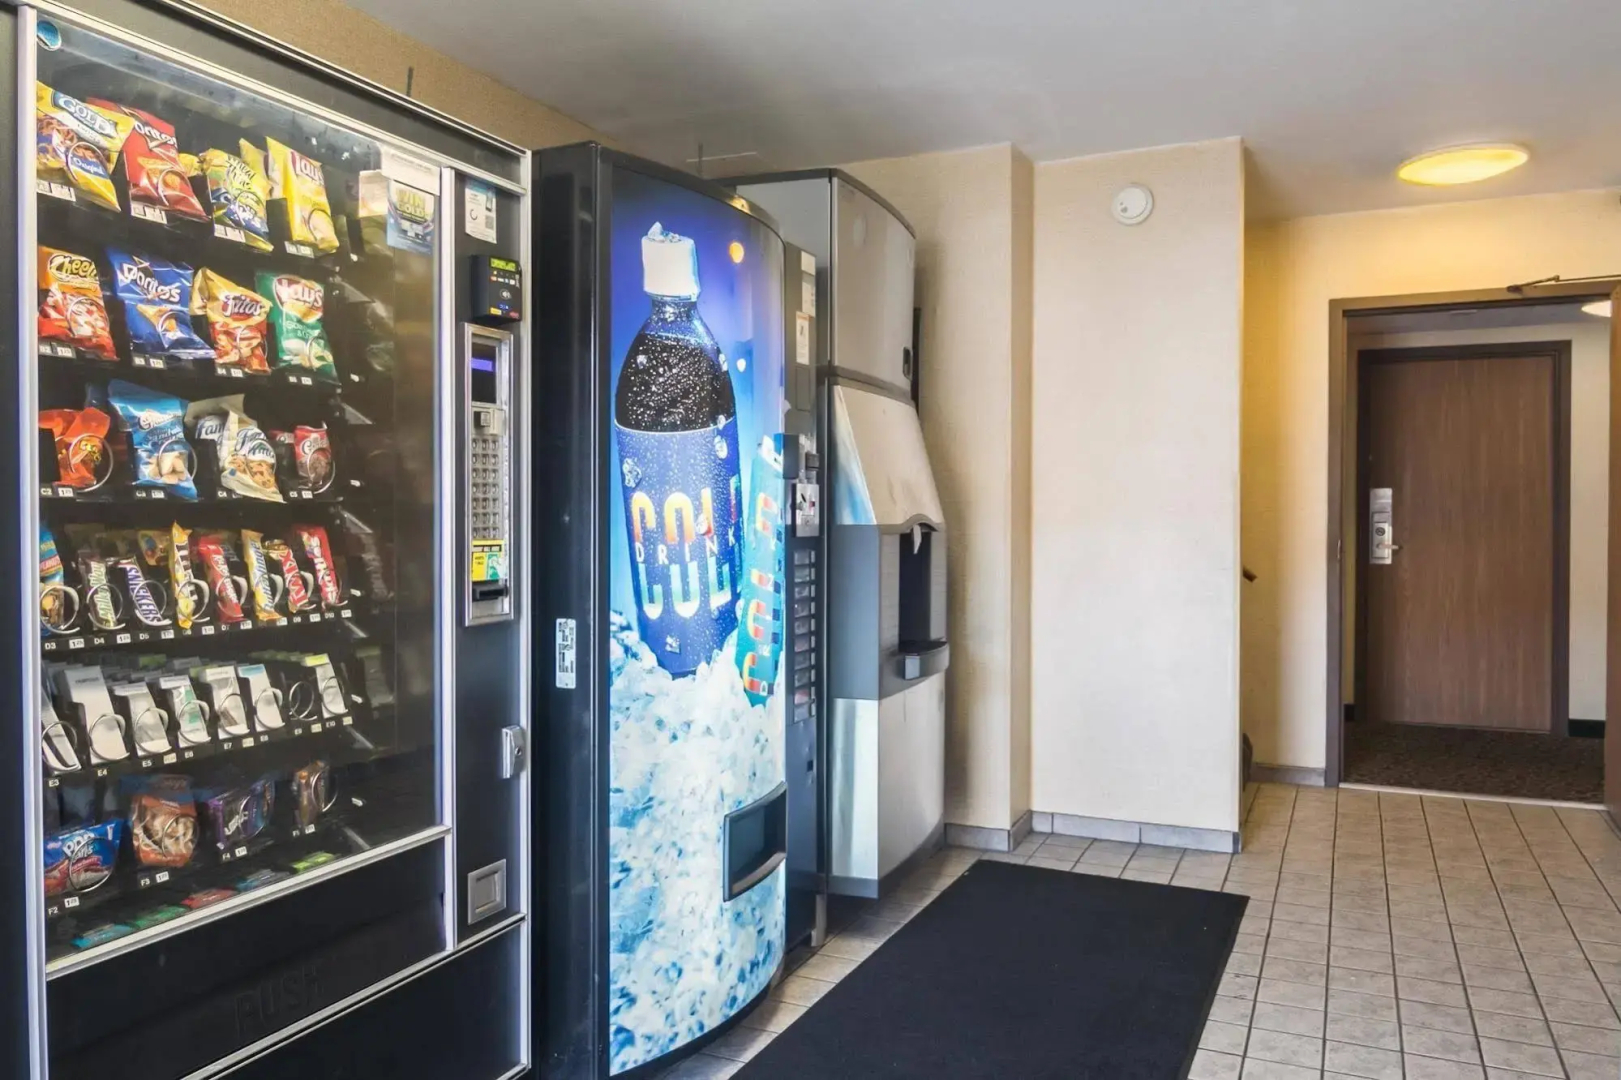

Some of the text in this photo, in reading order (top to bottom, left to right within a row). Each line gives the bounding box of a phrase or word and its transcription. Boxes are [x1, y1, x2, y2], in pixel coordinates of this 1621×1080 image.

[58, 97, 114, 137] GOLD
[121, 262, 181, 302] Doritos
[40, 487, 52, 495] C2
[126, 566, 164, 623] SNICKERS
[44, 642, 56, 650] D3
[97, 769, 107, 777] E4
[49, 778, 59, 787] E3
[140, 878, 150, 887] F3
[48, 906, 59, 916] F2
